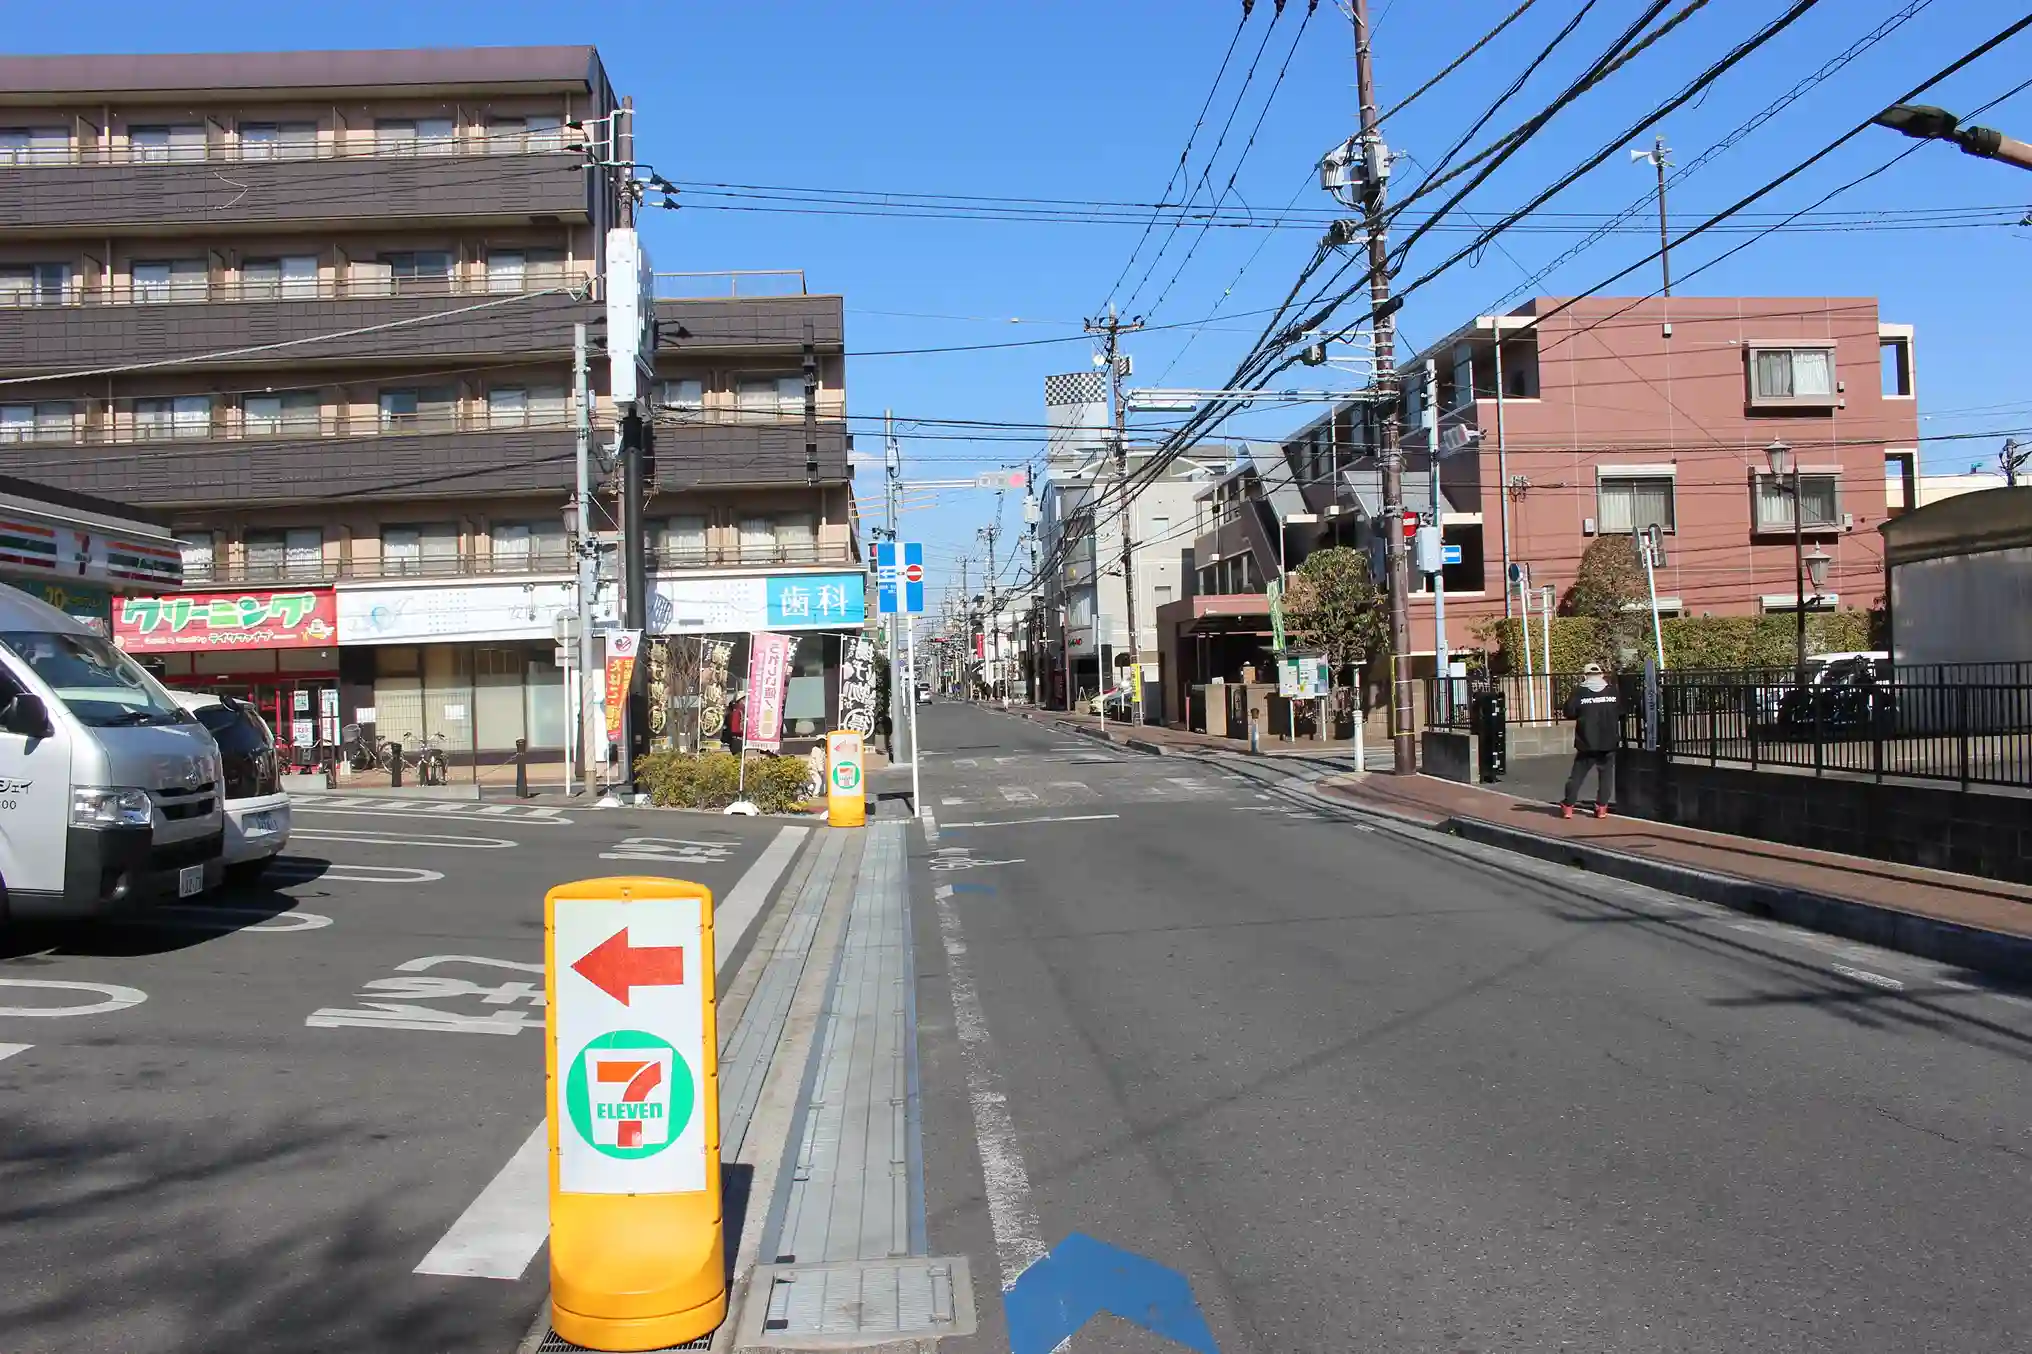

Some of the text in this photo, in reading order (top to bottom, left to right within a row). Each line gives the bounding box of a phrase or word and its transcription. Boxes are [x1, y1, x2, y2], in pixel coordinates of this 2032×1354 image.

[121, 590, 317, 636] クリーニング
[779, 584, 849, 617] 歯科
